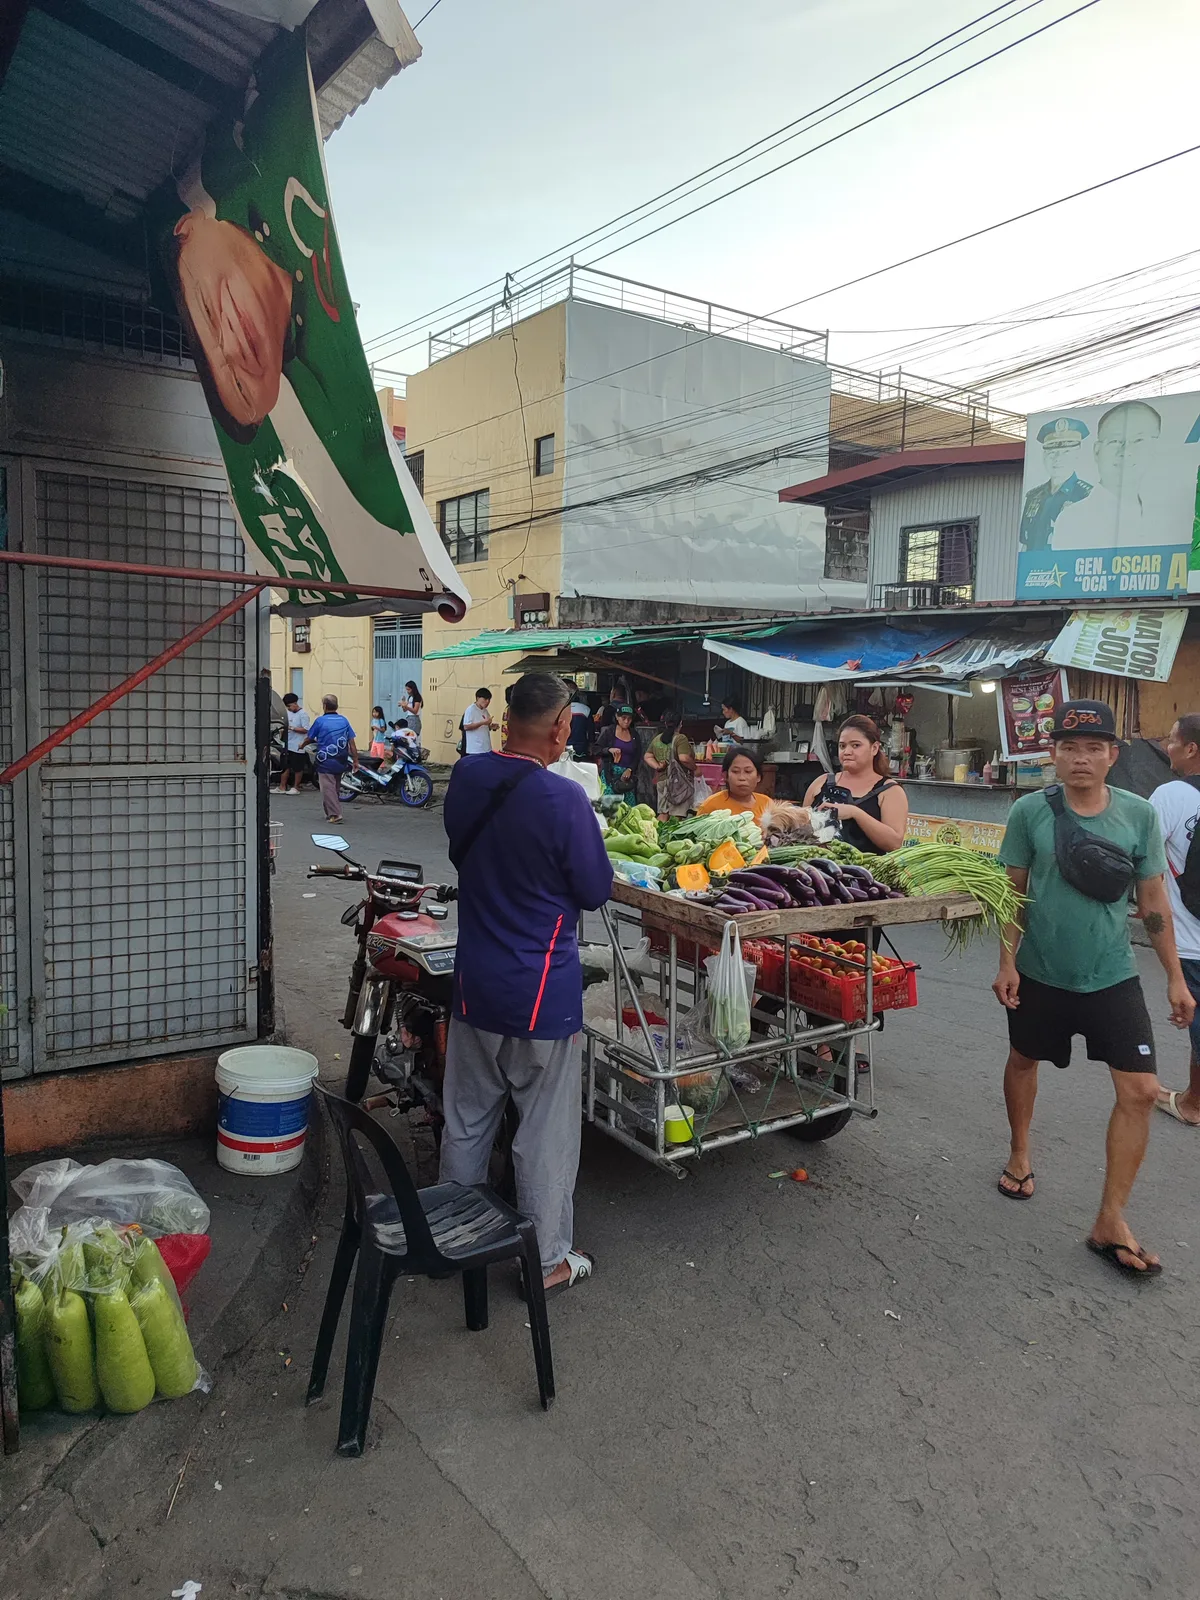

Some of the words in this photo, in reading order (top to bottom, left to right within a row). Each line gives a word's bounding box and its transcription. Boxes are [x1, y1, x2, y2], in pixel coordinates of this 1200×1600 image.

[1074, 557, 1107, 576] GEN.
[1111, 555, 1161, 574] OSCAR
[1120, 574, 1160, 591] DAVID
[1093, 627, 1131, 673] JON
[1127, 609, 1164, 678] MAYOR
[906, 826, 932, 838] ARES
[973, 825, 1002, 838] BEEF
[970, 834, 1001, 849] MAMI
